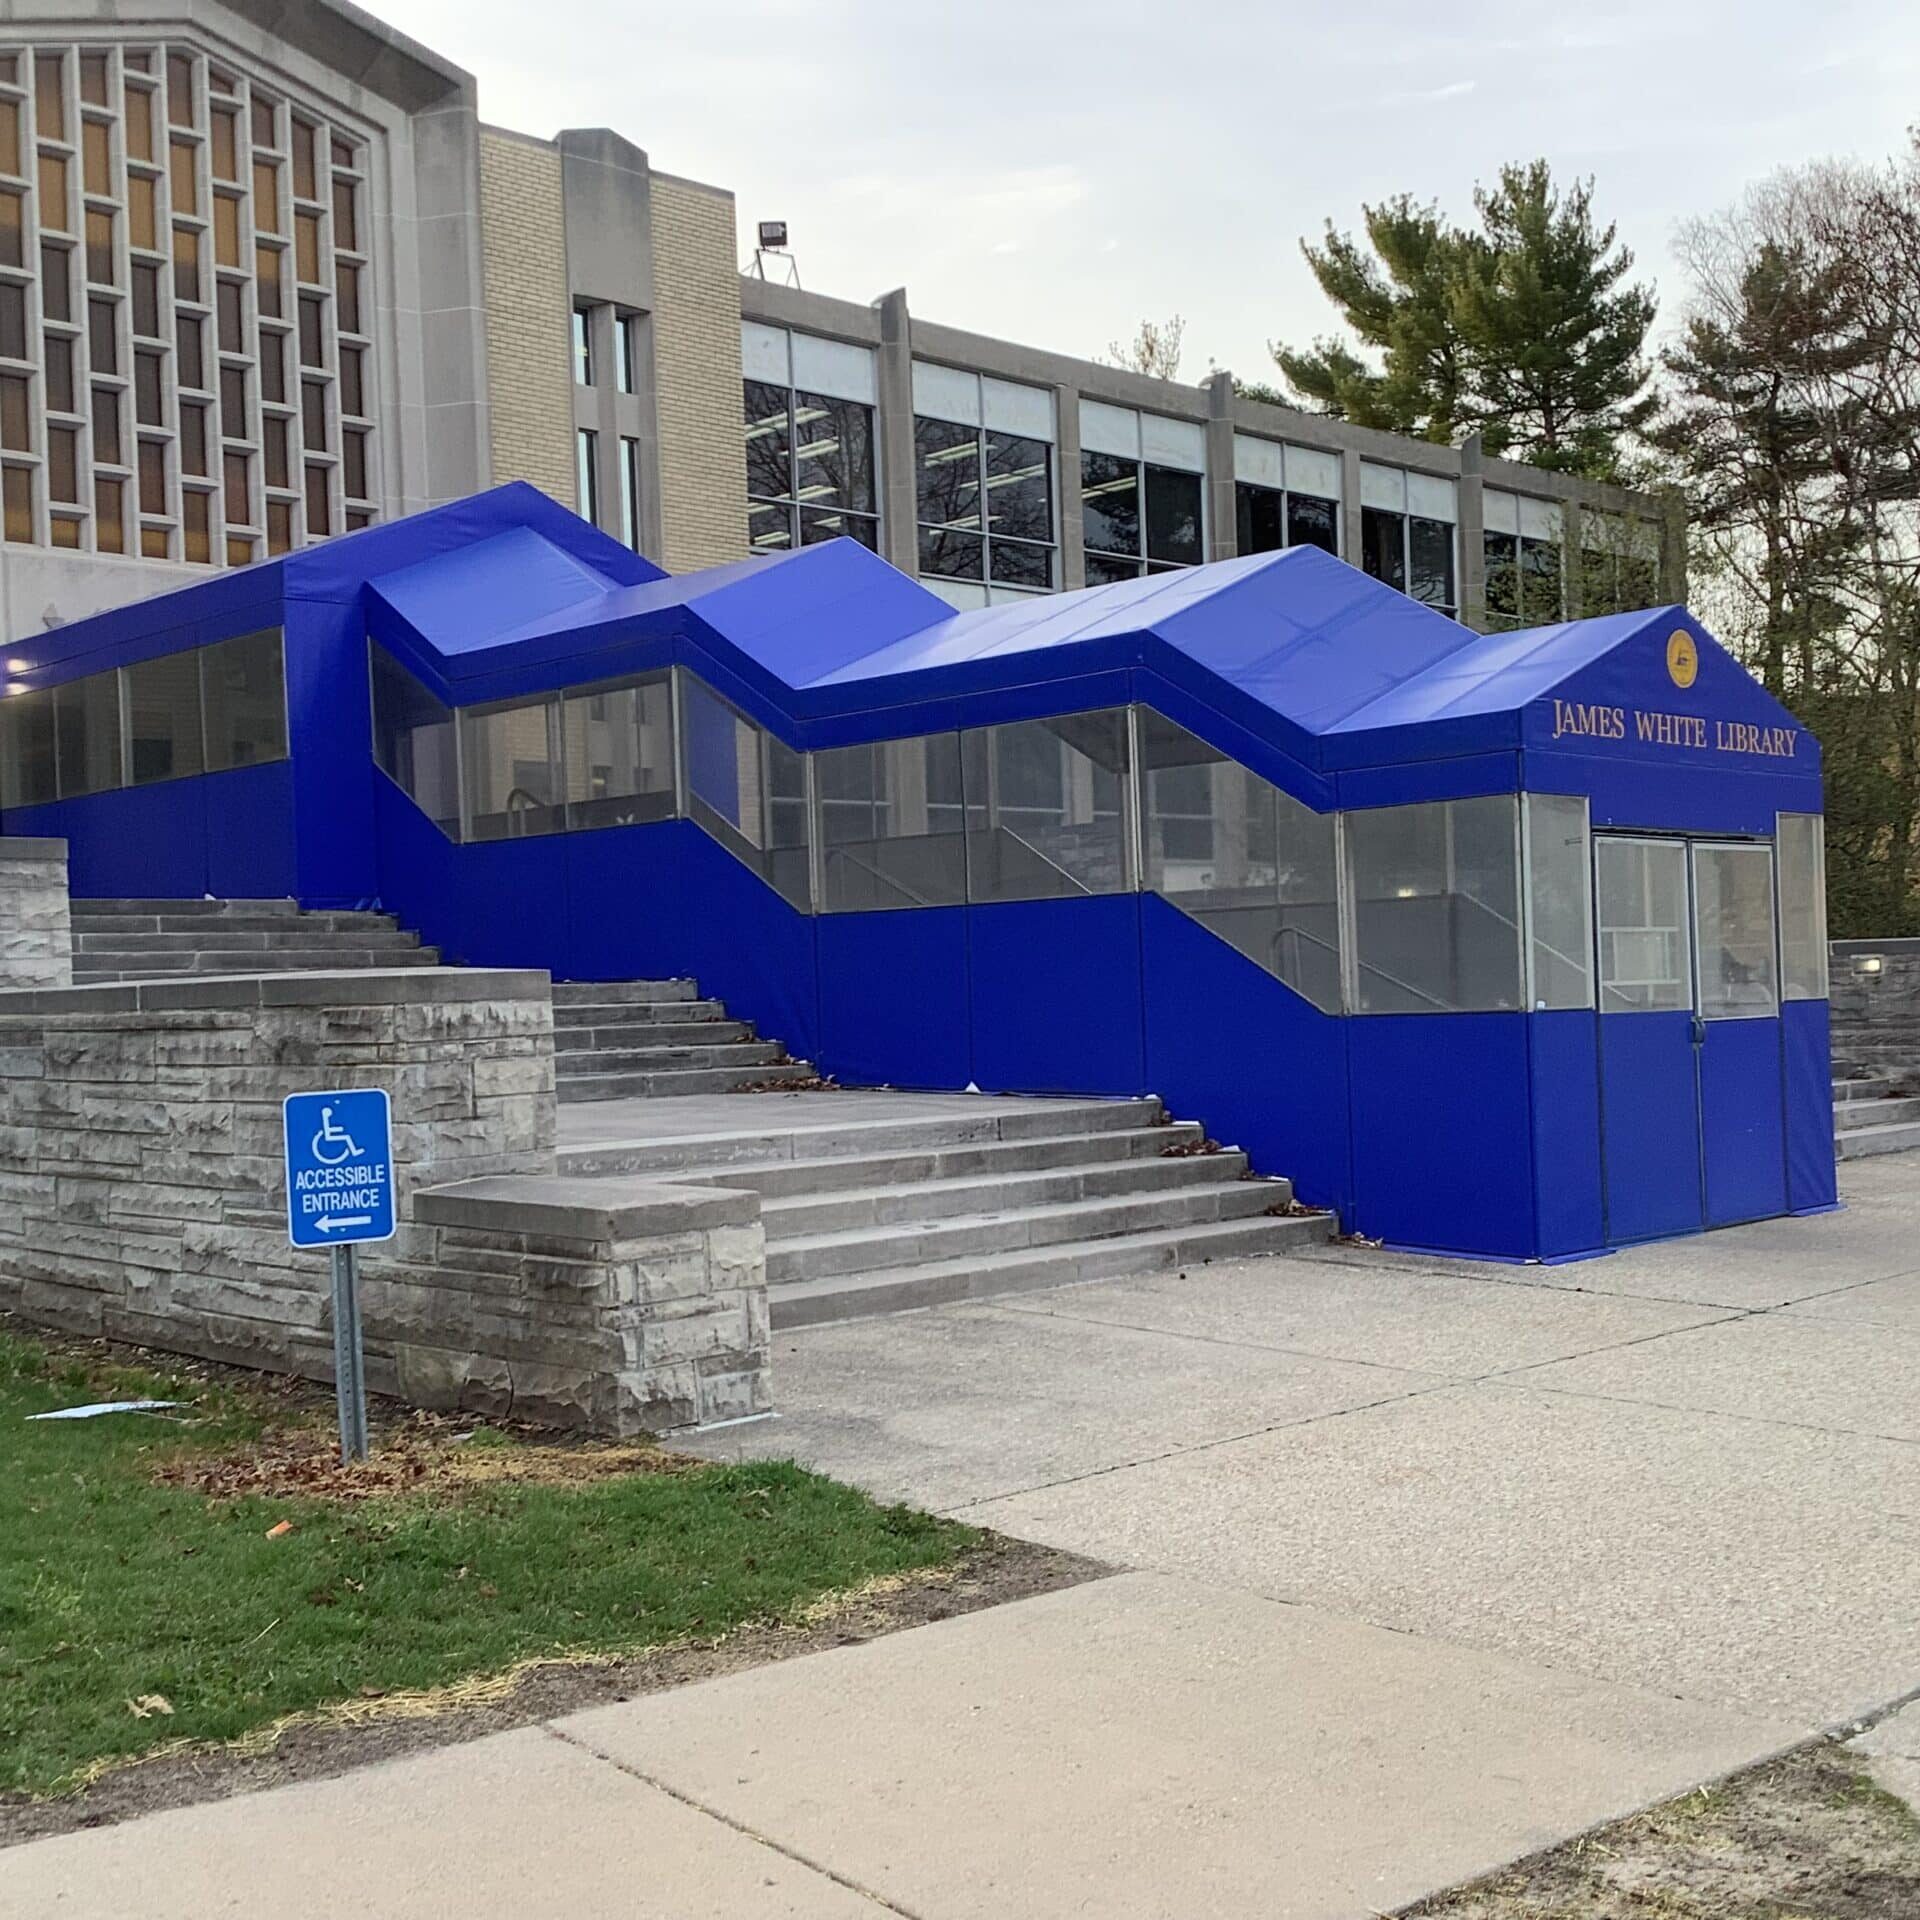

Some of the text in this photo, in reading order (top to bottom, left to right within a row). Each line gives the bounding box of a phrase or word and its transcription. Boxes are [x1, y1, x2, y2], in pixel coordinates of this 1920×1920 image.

[1552, 699, 1798, 757] JAMES WHITE LIBRARY
[295, 1164, 385, 1190] ACCESSIBLE
[302, 1188, 380, 1214] ENTRANCE
